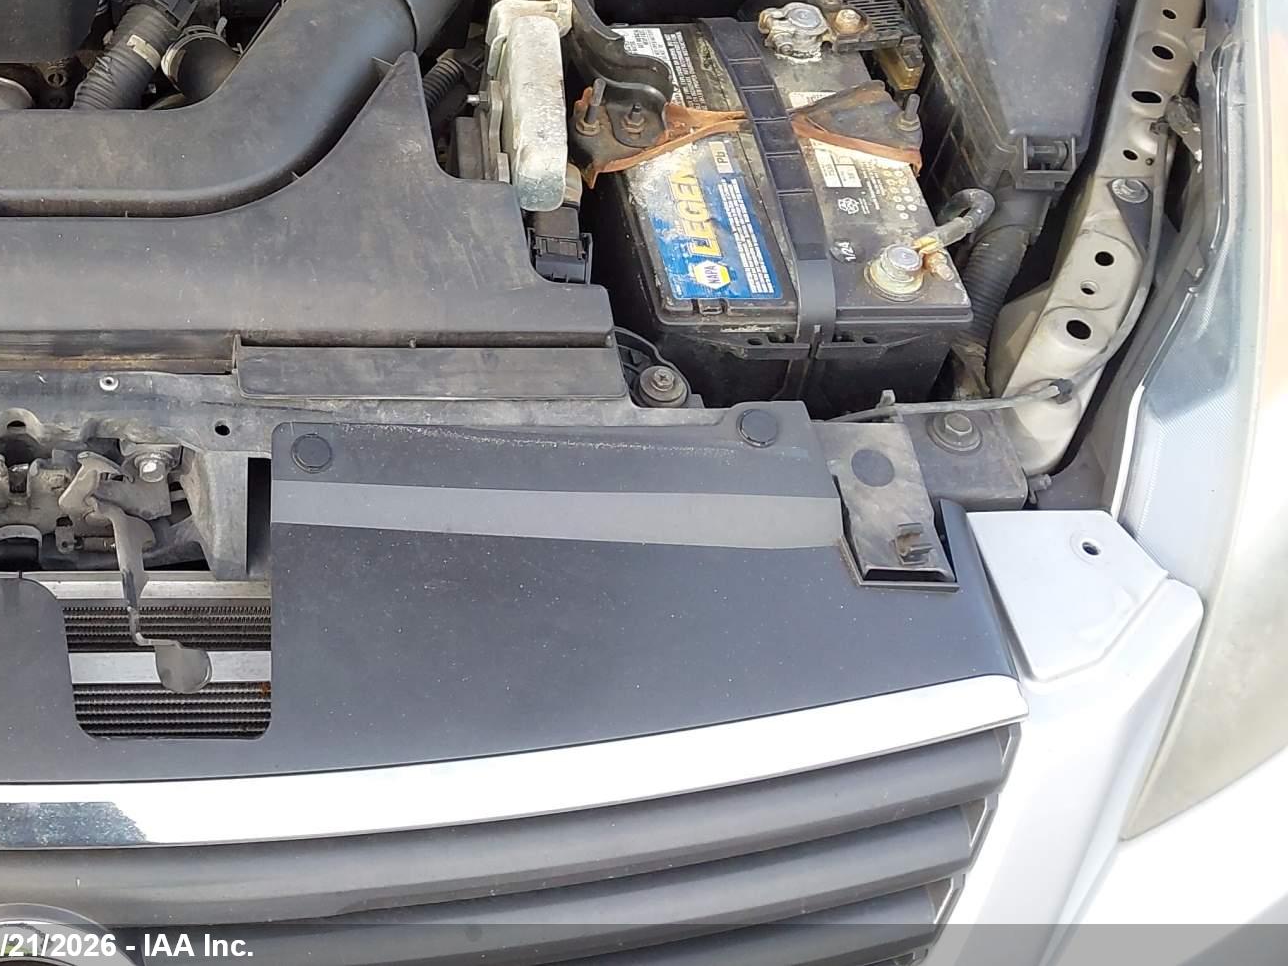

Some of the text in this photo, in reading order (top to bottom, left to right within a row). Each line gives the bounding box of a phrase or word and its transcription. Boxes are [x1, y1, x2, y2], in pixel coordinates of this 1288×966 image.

[717, 149, 729, 164] Pb
[667, 170, 723, 258] LEGEN
[838, 241, 857, 262] 1/24
[704, 265, 721, 285] NAPA
